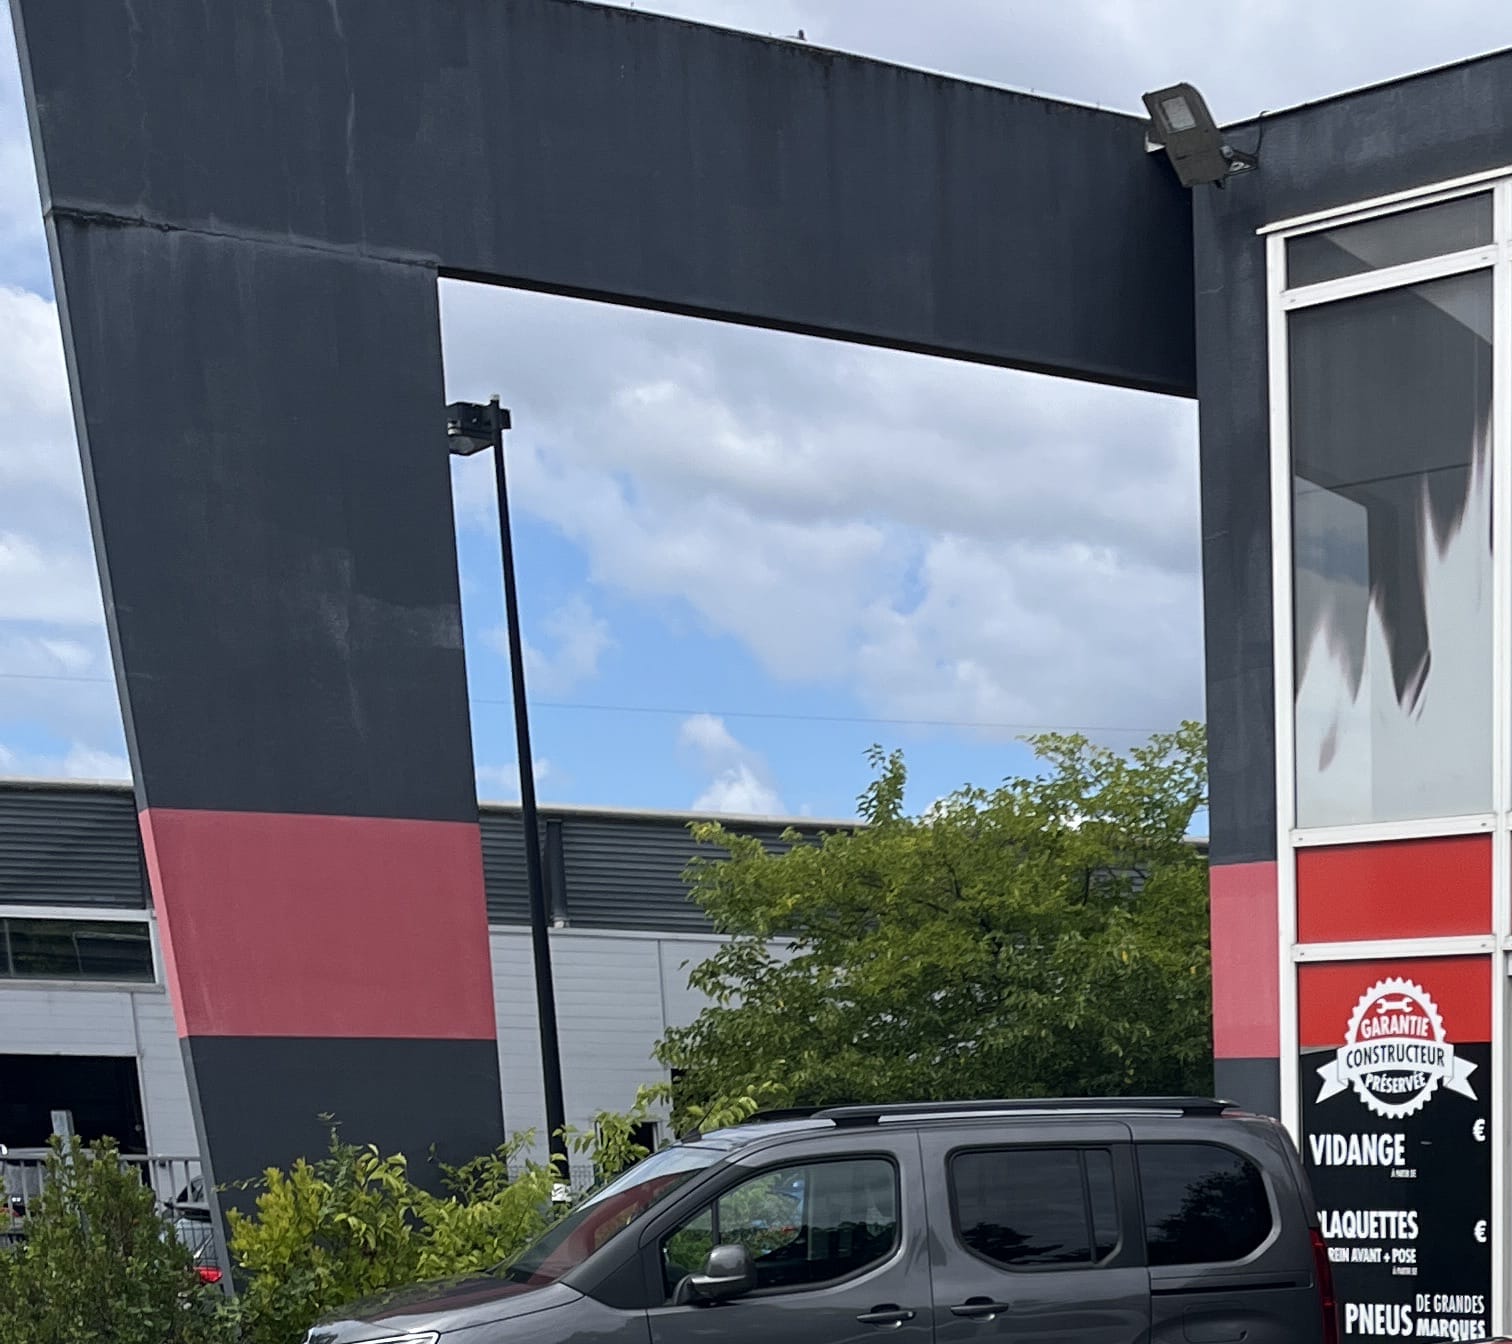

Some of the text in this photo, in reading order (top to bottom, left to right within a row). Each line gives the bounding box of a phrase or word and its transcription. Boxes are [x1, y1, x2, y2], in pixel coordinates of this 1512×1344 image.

[1360, 1014, 1430, 1039] GARANTIE
[1346, 1044, 1445, 1069] CONSTRUCTEUR
[1365, 1071, 1427, 1094] PRÉSERVÉE
[1472, 1118, 1486, 1142] €
[1309, 1133, 1406, 1167] VIDANGE
[1317, 1210, 1419, 1240] LAQUETTES
[1327, 1247, 1350, 1263] REIN
[1351, 1247, 1382, 1263] AVANT
[1391, 1248, 1417, 1264] POSE
[1416, 1294, 1485, 1315] DE GRANDES
[1344, 1303, 1414, 1337] PNEUS
[1415, 1318, 1486, 1343] MARQUES
